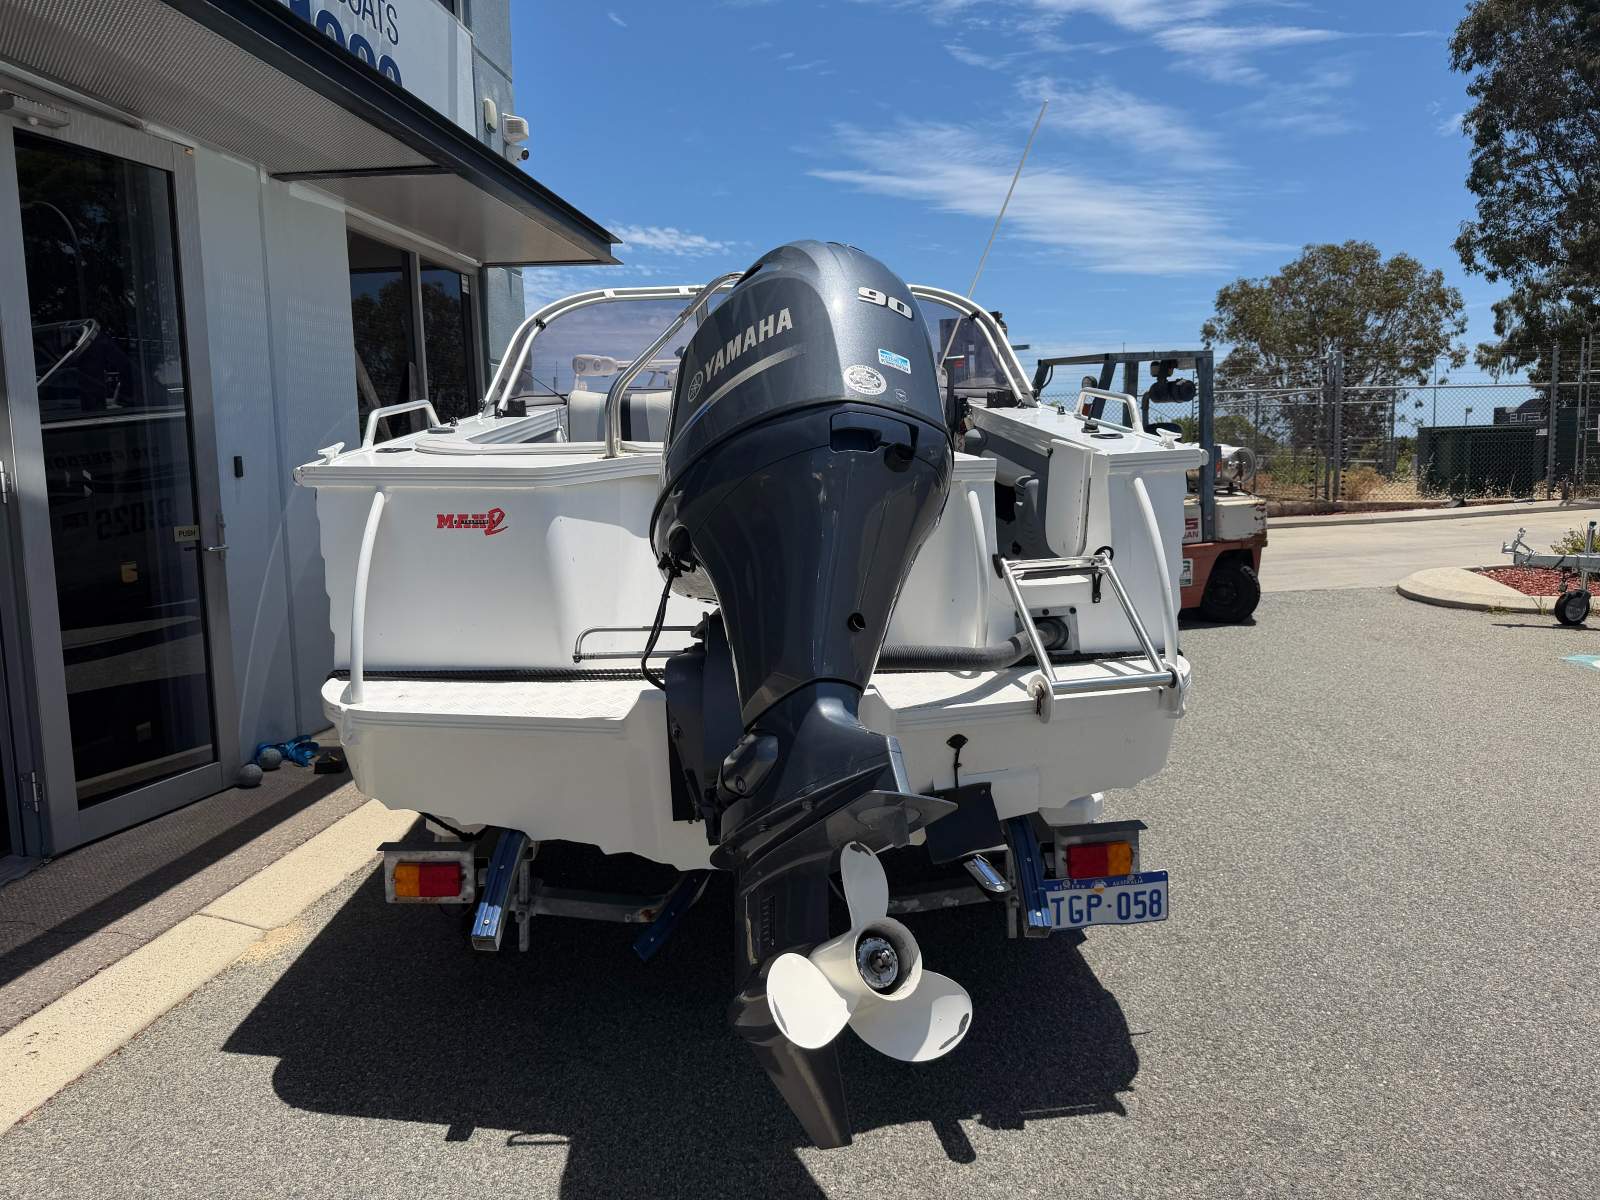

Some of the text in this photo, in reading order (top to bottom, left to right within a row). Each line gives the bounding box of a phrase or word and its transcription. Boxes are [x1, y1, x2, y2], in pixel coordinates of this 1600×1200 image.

[857, 286, 913, 320] 90
[705, 307, 793, 383] YAMAHA
[178, 529, 196, 537] PUSH
